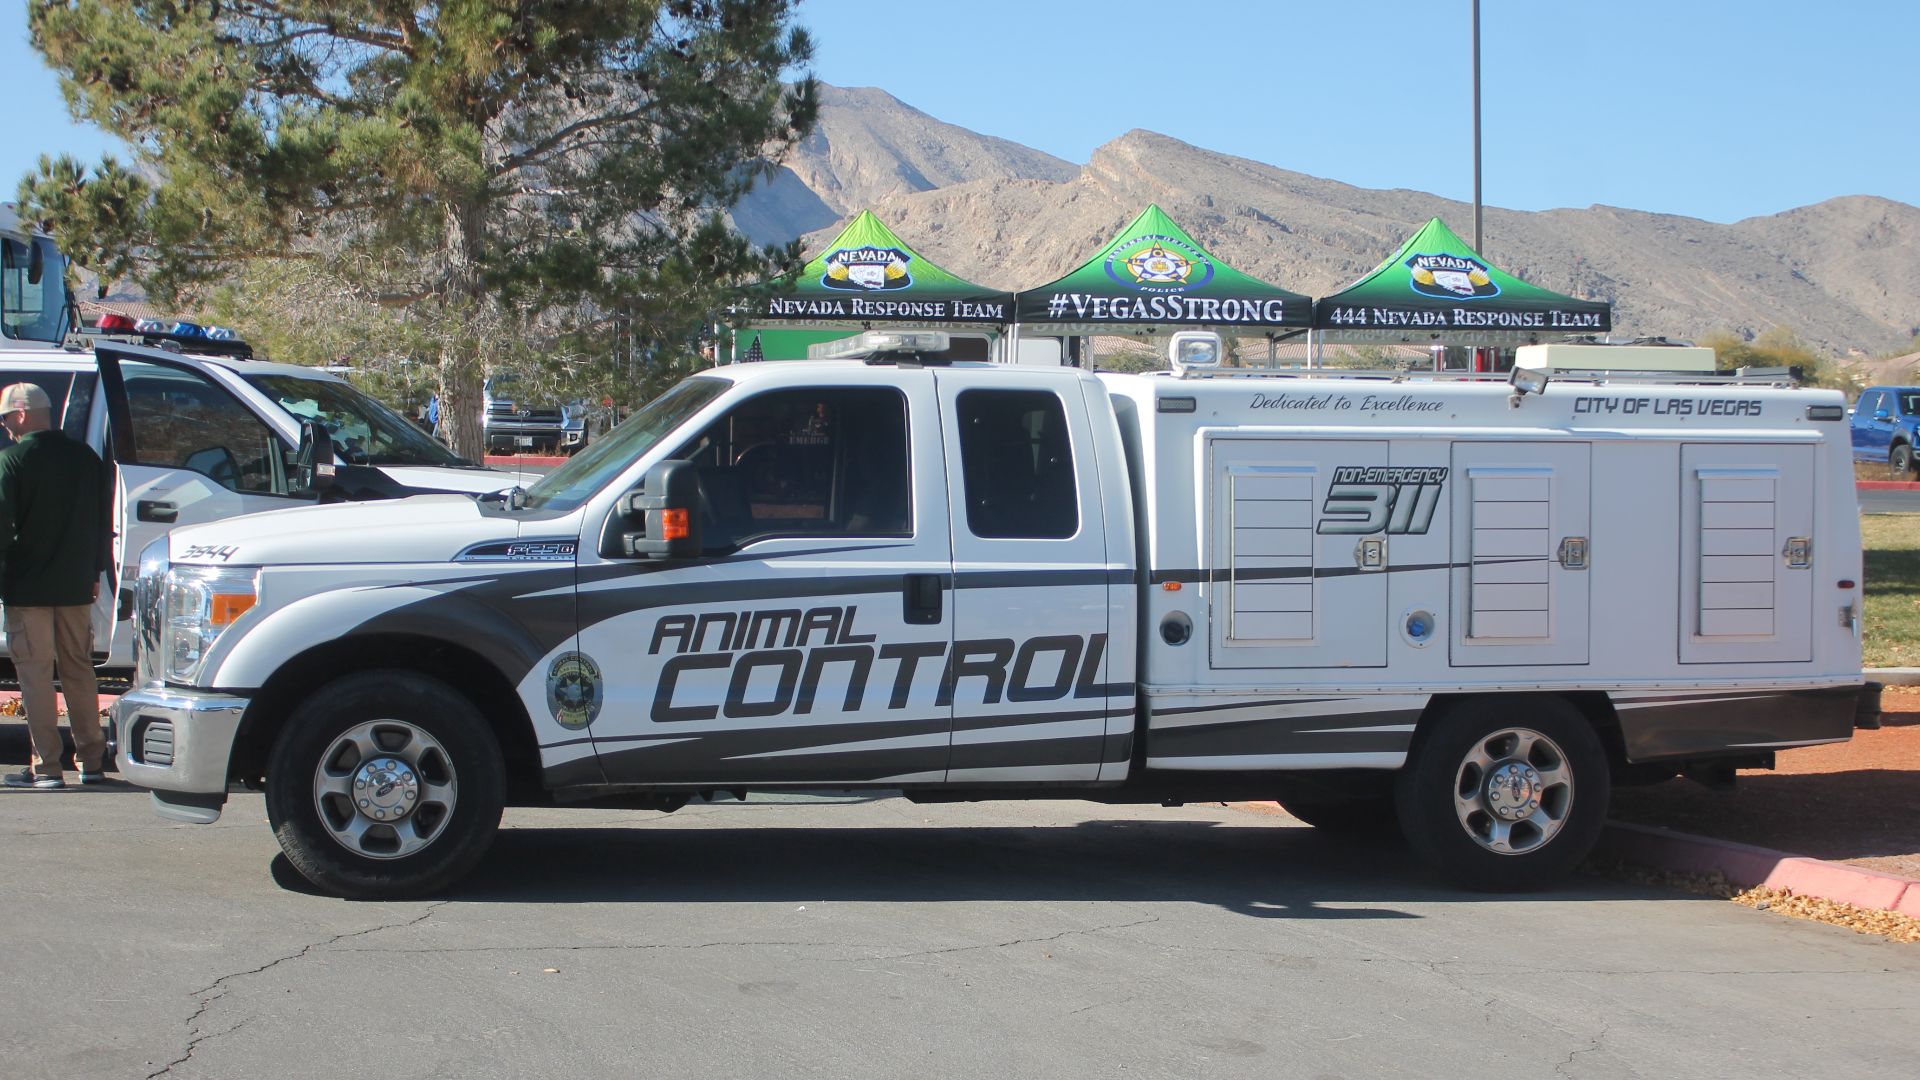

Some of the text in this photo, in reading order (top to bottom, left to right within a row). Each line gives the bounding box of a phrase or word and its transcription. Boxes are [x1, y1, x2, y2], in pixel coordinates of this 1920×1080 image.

[838, 250, 896, 262] NEVADA
[1417, 257, 1475, 269] NEVADA
[769, 298, 845, 315] NEVADA
[851, 298, 945, 317] RESPONSE
[951, 300, 1003, 318] TEAM
[1330, 308, 1600, 327] 444 NEVADA RESPONSE TEAM
[1250, 393, 1445, 412] Dedicated to Excellence
[1574, 397, 1762, 416] CITY OF LAS VEGAS
[1332, 467, 1448, 483] NON-EMERGENCY
[1316, 483, 1442, 535] 311
[648, 605, 876, 655] ANIMAL
[650, 633, 1135, 723] CONTROL
